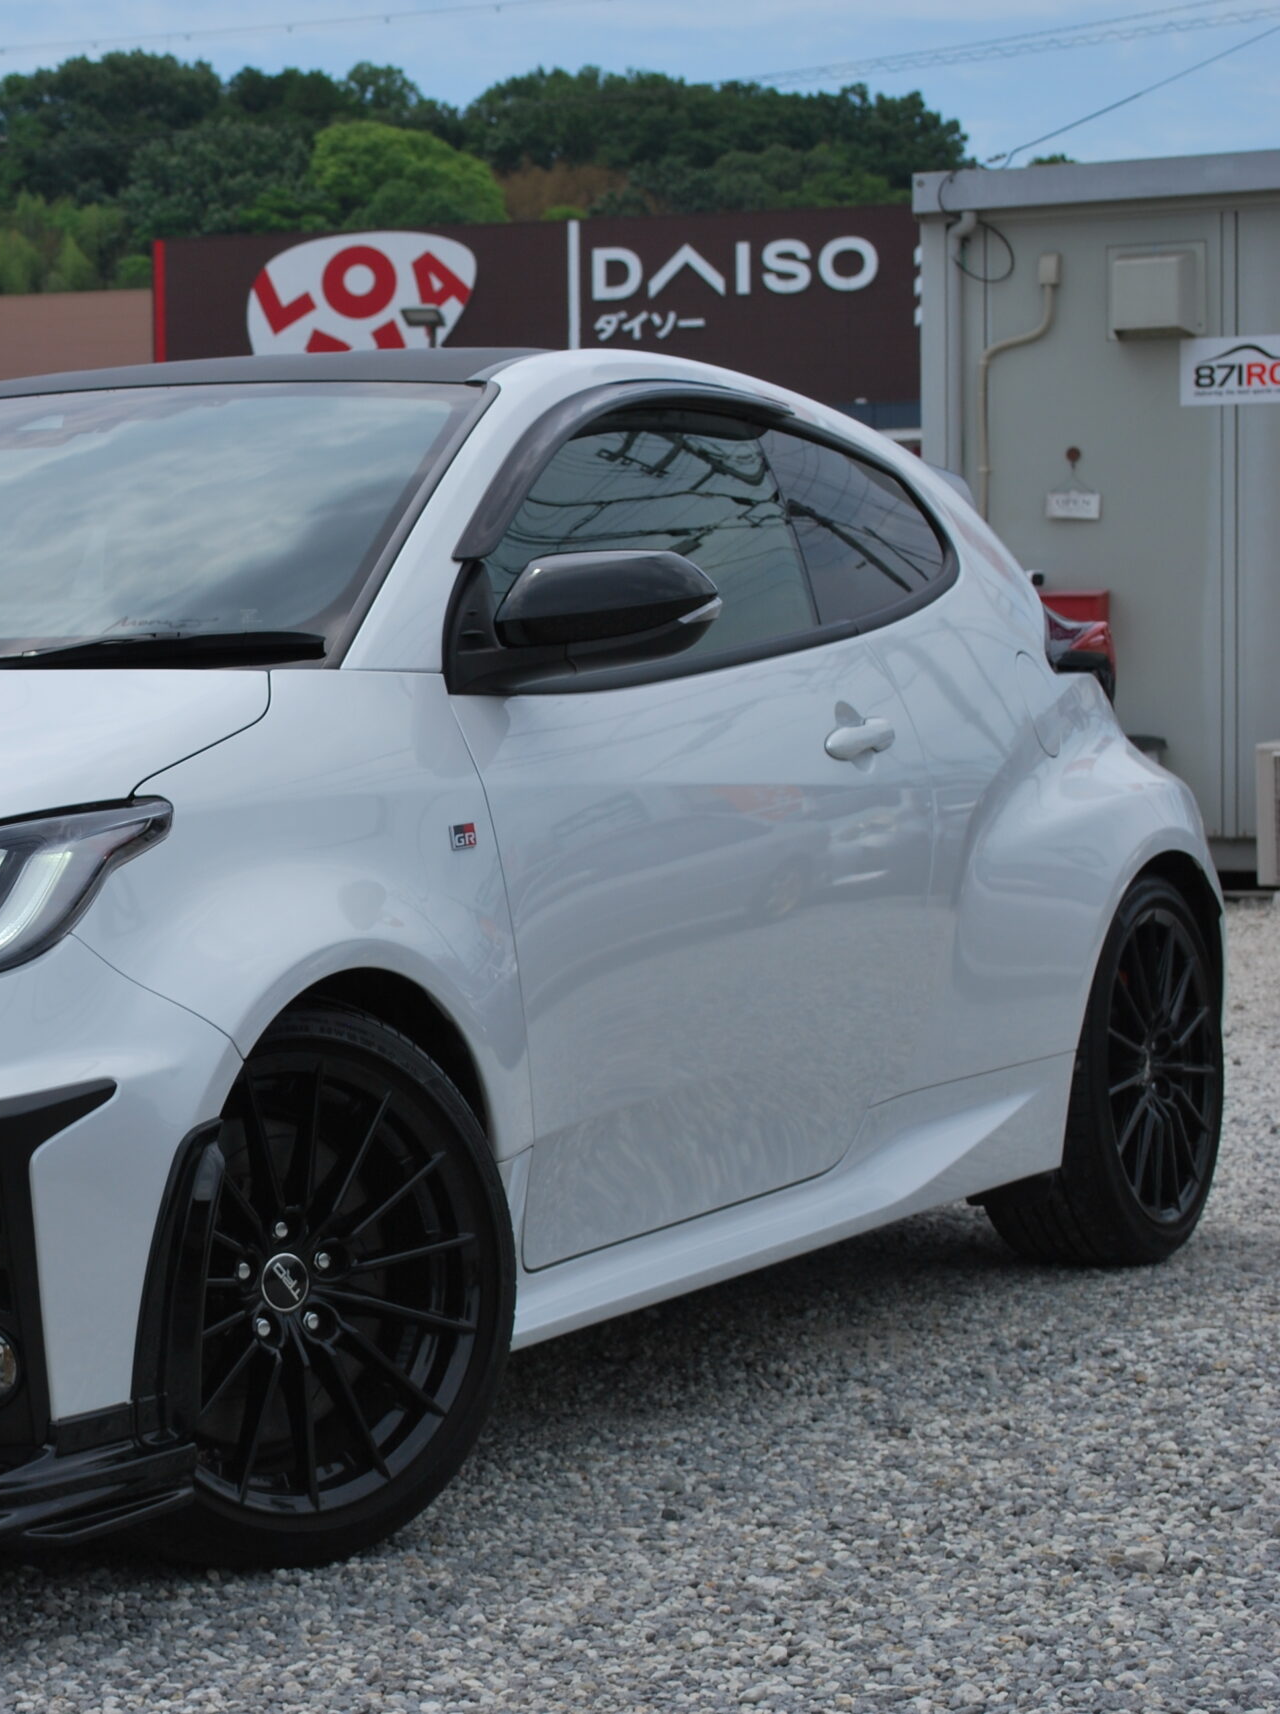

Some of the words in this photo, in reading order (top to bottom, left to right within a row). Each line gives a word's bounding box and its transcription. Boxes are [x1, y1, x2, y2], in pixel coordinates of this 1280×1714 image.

[592, 236, 879, 300] DAISO
[593, 310, 706, 341] ダイソー
[272, 1262, 301, 1301] TRD
